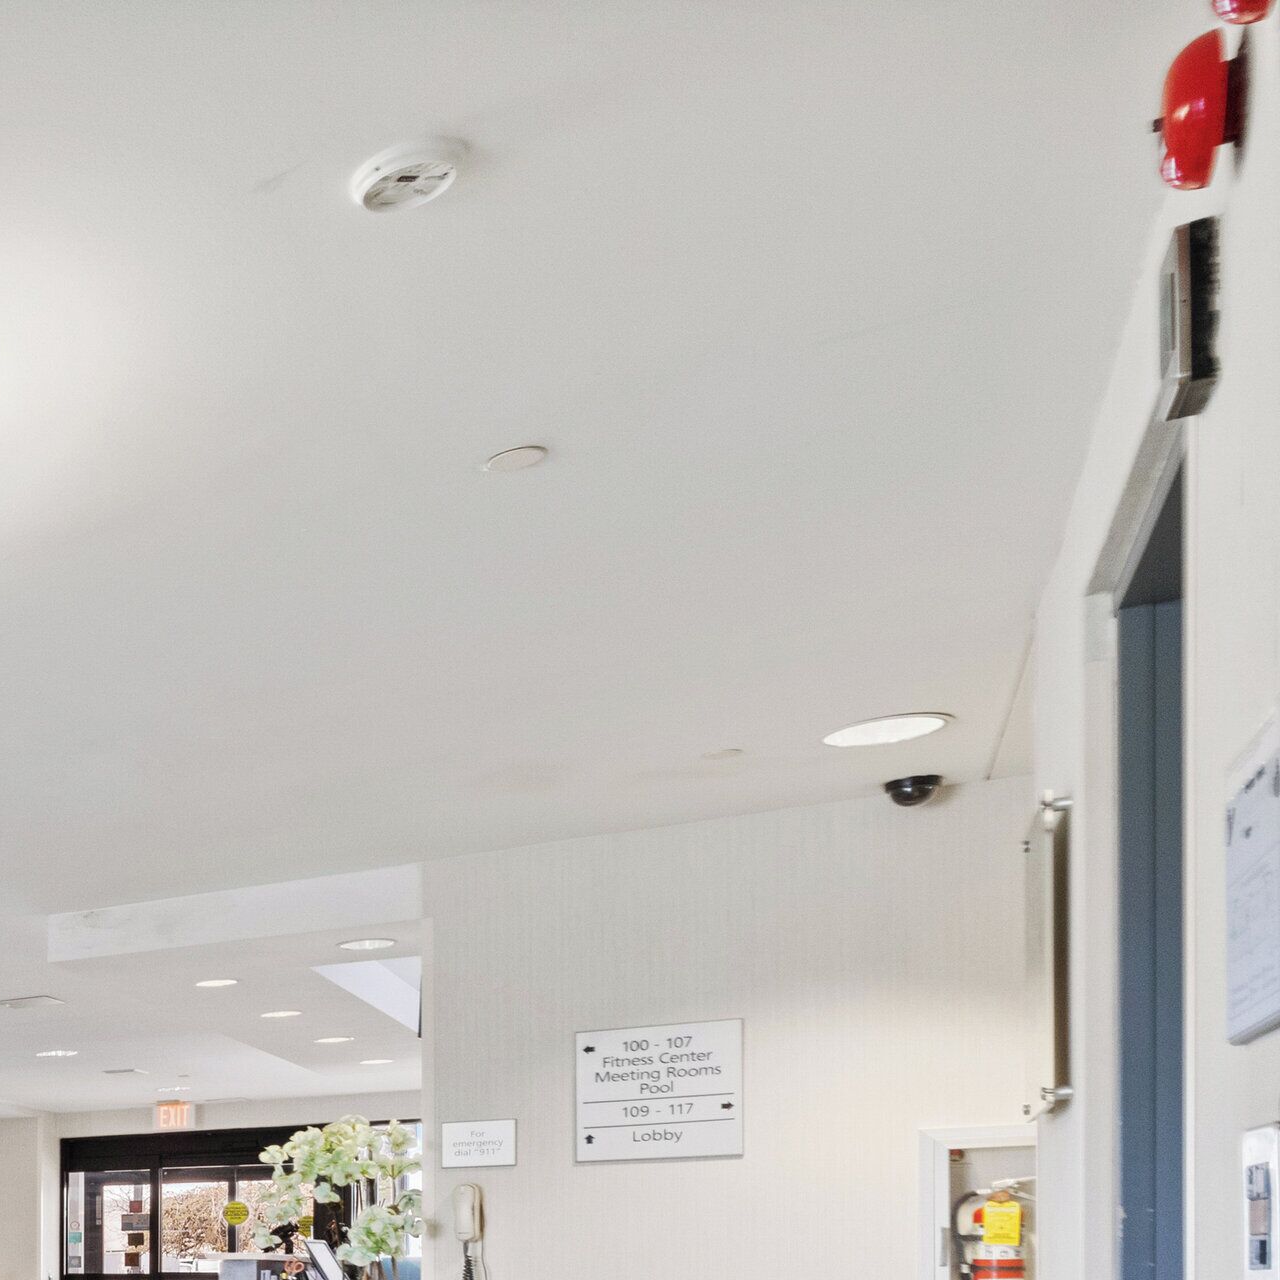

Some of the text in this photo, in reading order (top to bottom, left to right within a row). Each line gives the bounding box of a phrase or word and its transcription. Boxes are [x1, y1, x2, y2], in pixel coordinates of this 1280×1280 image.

[622, 1040, 649, 1052] 100
[666, 1036, 692, 1049] 107
[602, 1051, 713, 1069] Fitness Center
[595, 1065, 722, 1083] Meeting Rooms
[639, 1081, 674, 1094] Pool
[160, 1105, 189, 1127] EXIT
[622, 1105, 649, 1118] 109
[668, 1102, 694, 1115] 117
[452, 1140, 504, 1148] emergency
[632, 1129, 683, 1145] Lobby
[454, 1149, 471, 1157] dial
